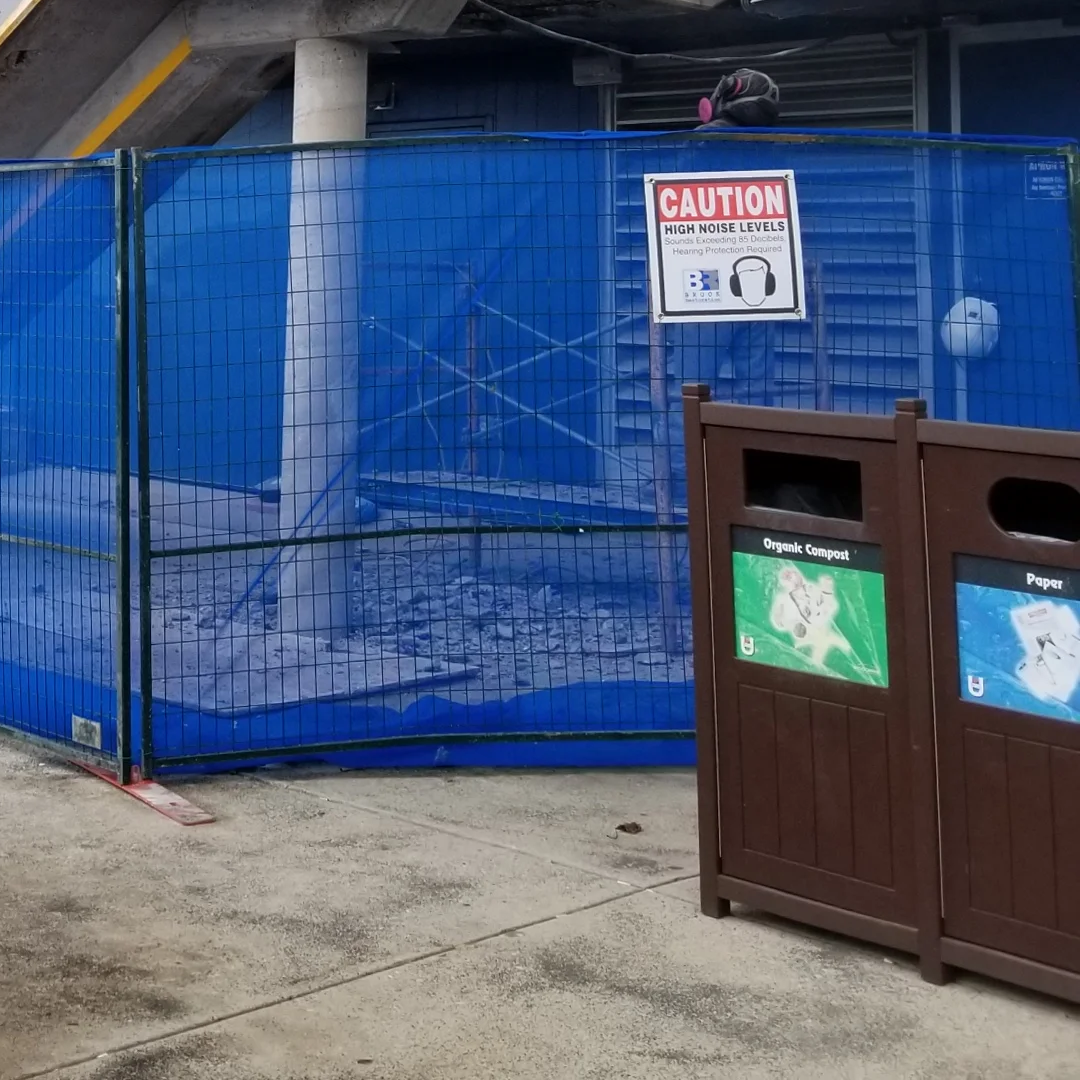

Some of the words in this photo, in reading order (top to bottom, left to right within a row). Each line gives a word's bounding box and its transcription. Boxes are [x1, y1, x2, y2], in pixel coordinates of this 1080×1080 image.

[659, 185, 785, 219] CAUTION
[664, 223, 695, 235] HIGH
[699, 222, 736, 234] NOISE
[740, 221, 785, 232] LEVELS
[664, 237, 694, 246] Sounds
[696, 236, 737, 245] Exceeding
[738, 235, 749, 243] 85
[672, 247, 704, 256] Hearing
[705, 246, 745, 255] Protection
[746, 245, 783, 254] Required
[763, 537, 803, 554] Organic
[805, 543, 850, 561] Compost
[1026, 572, 1063, 590] Paper
